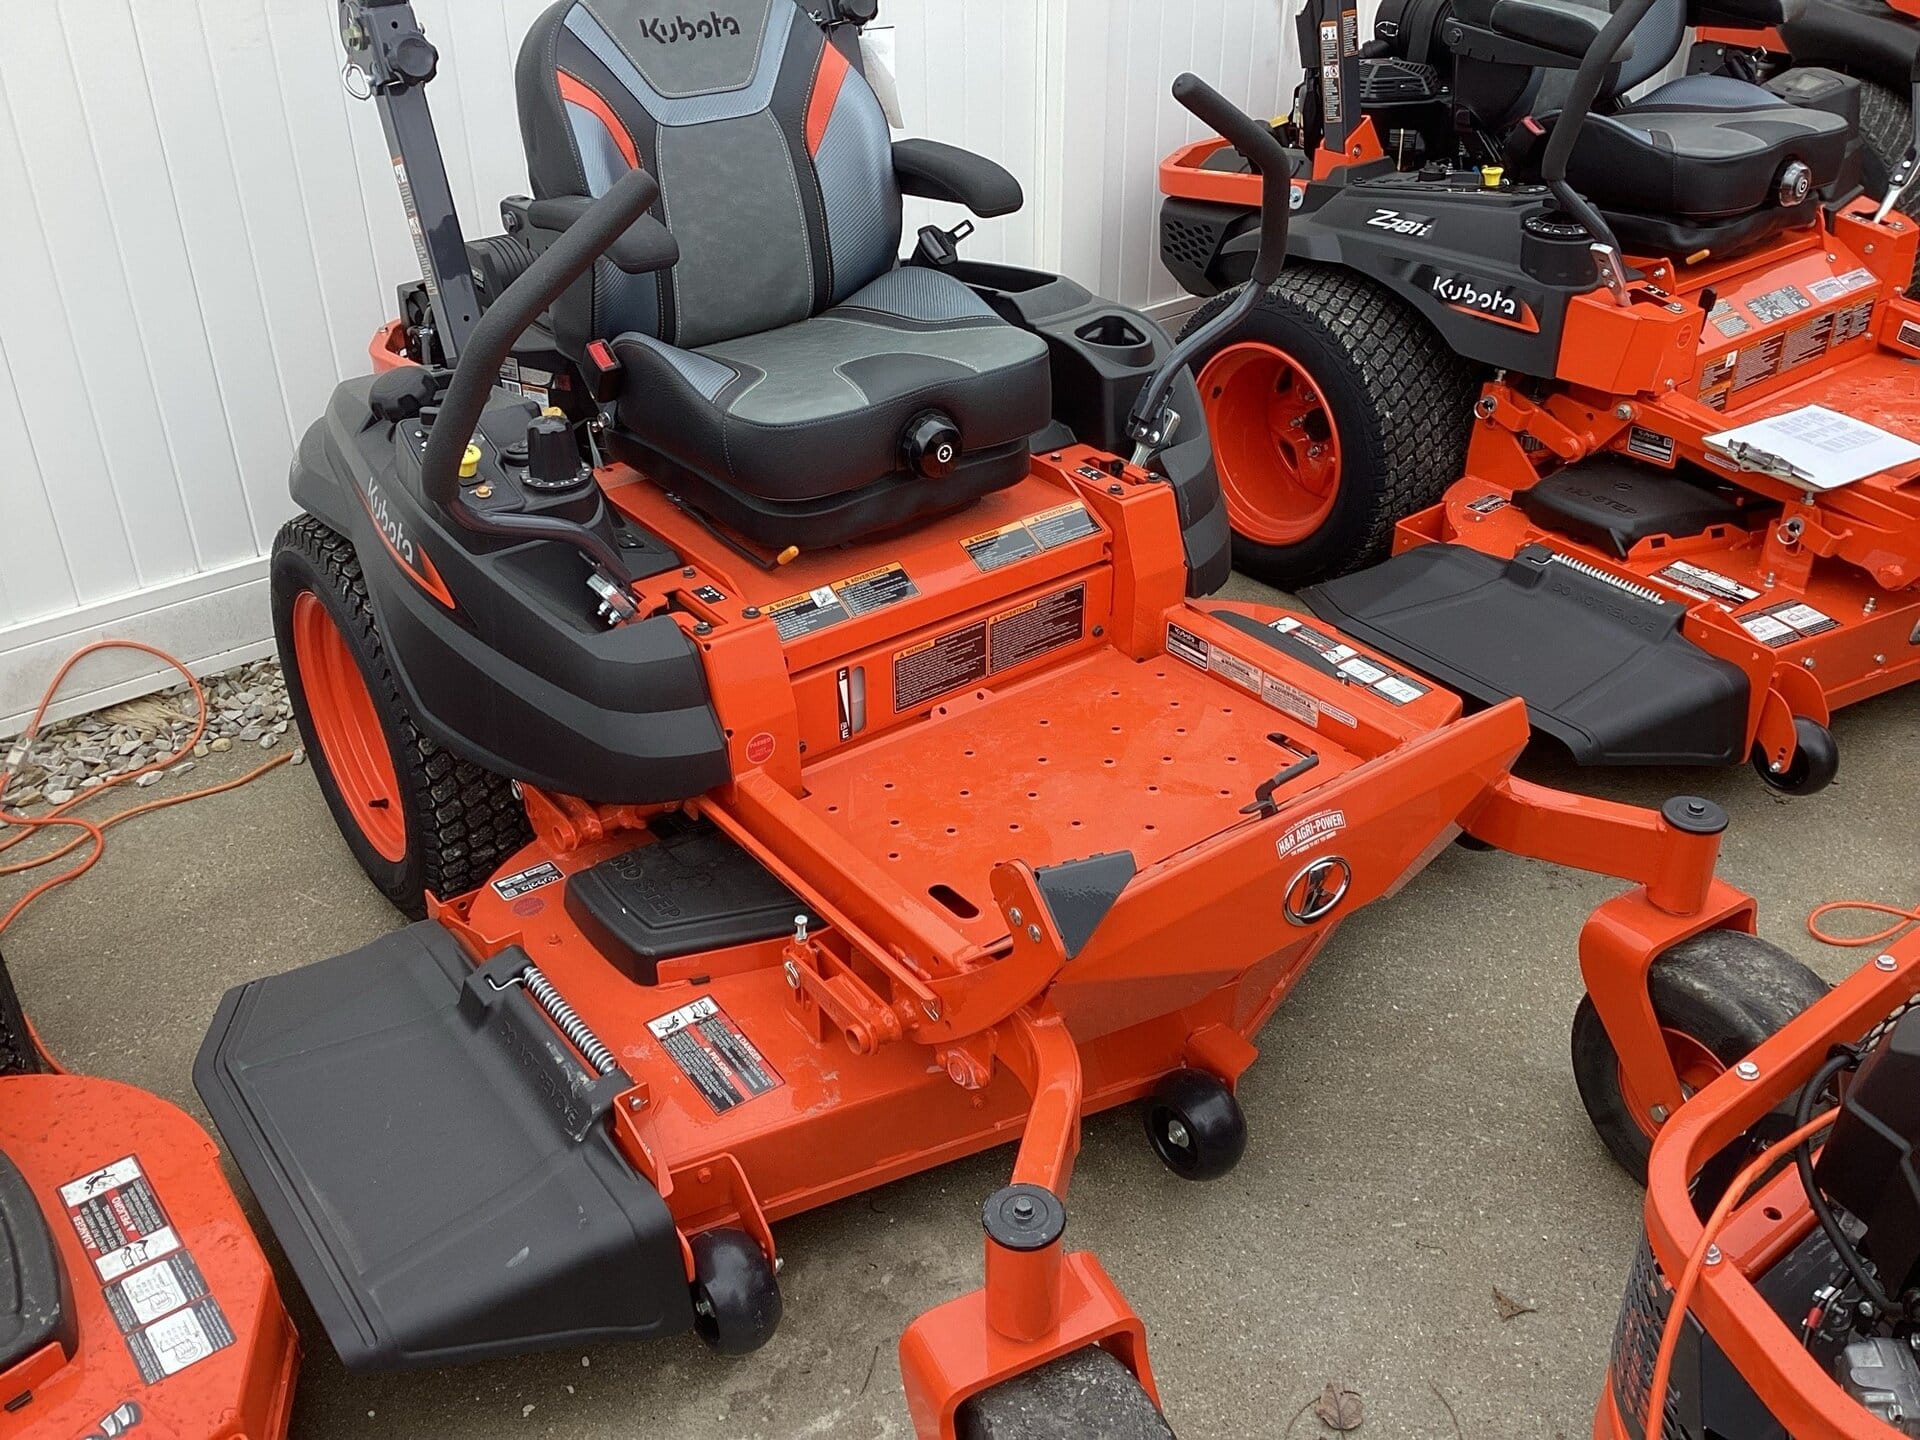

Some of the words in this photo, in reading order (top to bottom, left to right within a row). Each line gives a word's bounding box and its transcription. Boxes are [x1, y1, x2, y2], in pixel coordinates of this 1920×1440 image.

[639, 11, 740, 44] Kubota
[1366, 208, 1432, 236] Z781i
[1432, 276, 1516, 315] Kubota
[367, 476, 413, 564] Kubota
[850, 567, 890, 583] ADVERTENCIA
[839, 670, 846, 679] F
[842, 729, 848, 738] E
[1279, 833, 1296, 855] H&R
[1295, 813, 1344, 843] AGRI-POWER
[610, 855, 643, 880] NO
[635, 880, 681, 918] STEP
[708, 1051, 733, 1078] PELIGRO
[738, 1037, 762, 1063] DANGER
[111, 1196, 132, 1227] PELIGRO
[72, 1215, 93, 1248] DANGER
